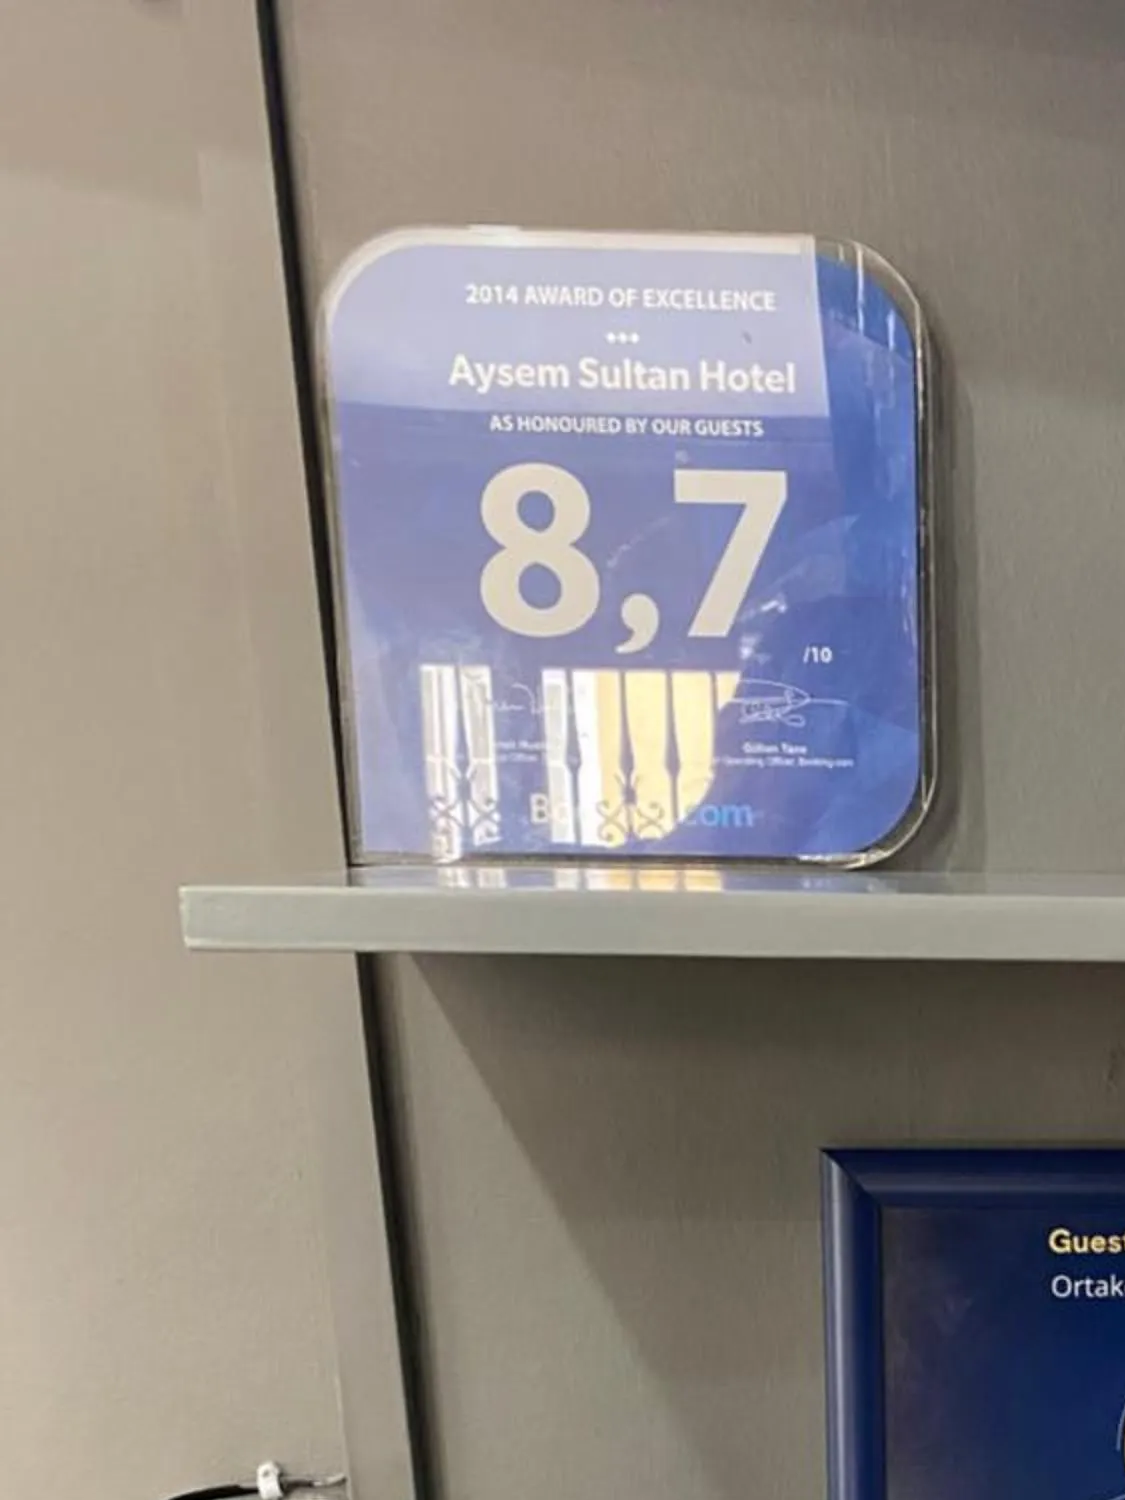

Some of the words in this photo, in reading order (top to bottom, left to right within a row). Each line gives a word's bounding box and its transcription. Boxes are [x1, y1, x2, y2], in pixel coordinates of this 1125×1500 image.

[466, 283, 518, 305] 2014
[525, 285, 603, 307] AWARD
[608, 288, 639, 308] OF
[643, 289, 776, 312] EXCELLENCE
[449, 354, 570, 394] Aysem
[578, 356, 690, 391] Sultan
[700, 360, 796, 394] Hotel
[490, 415, 514, 432] AS
[517, 416, 622, 434] HONOURED
[625, 417, 648, 434] BY
[652, 418, 692, 436] OUR
[695, 419, 765, 438] GUESTS
[480, 462, 787, 654] 8,7
[803, 647, 833, 663] /10
